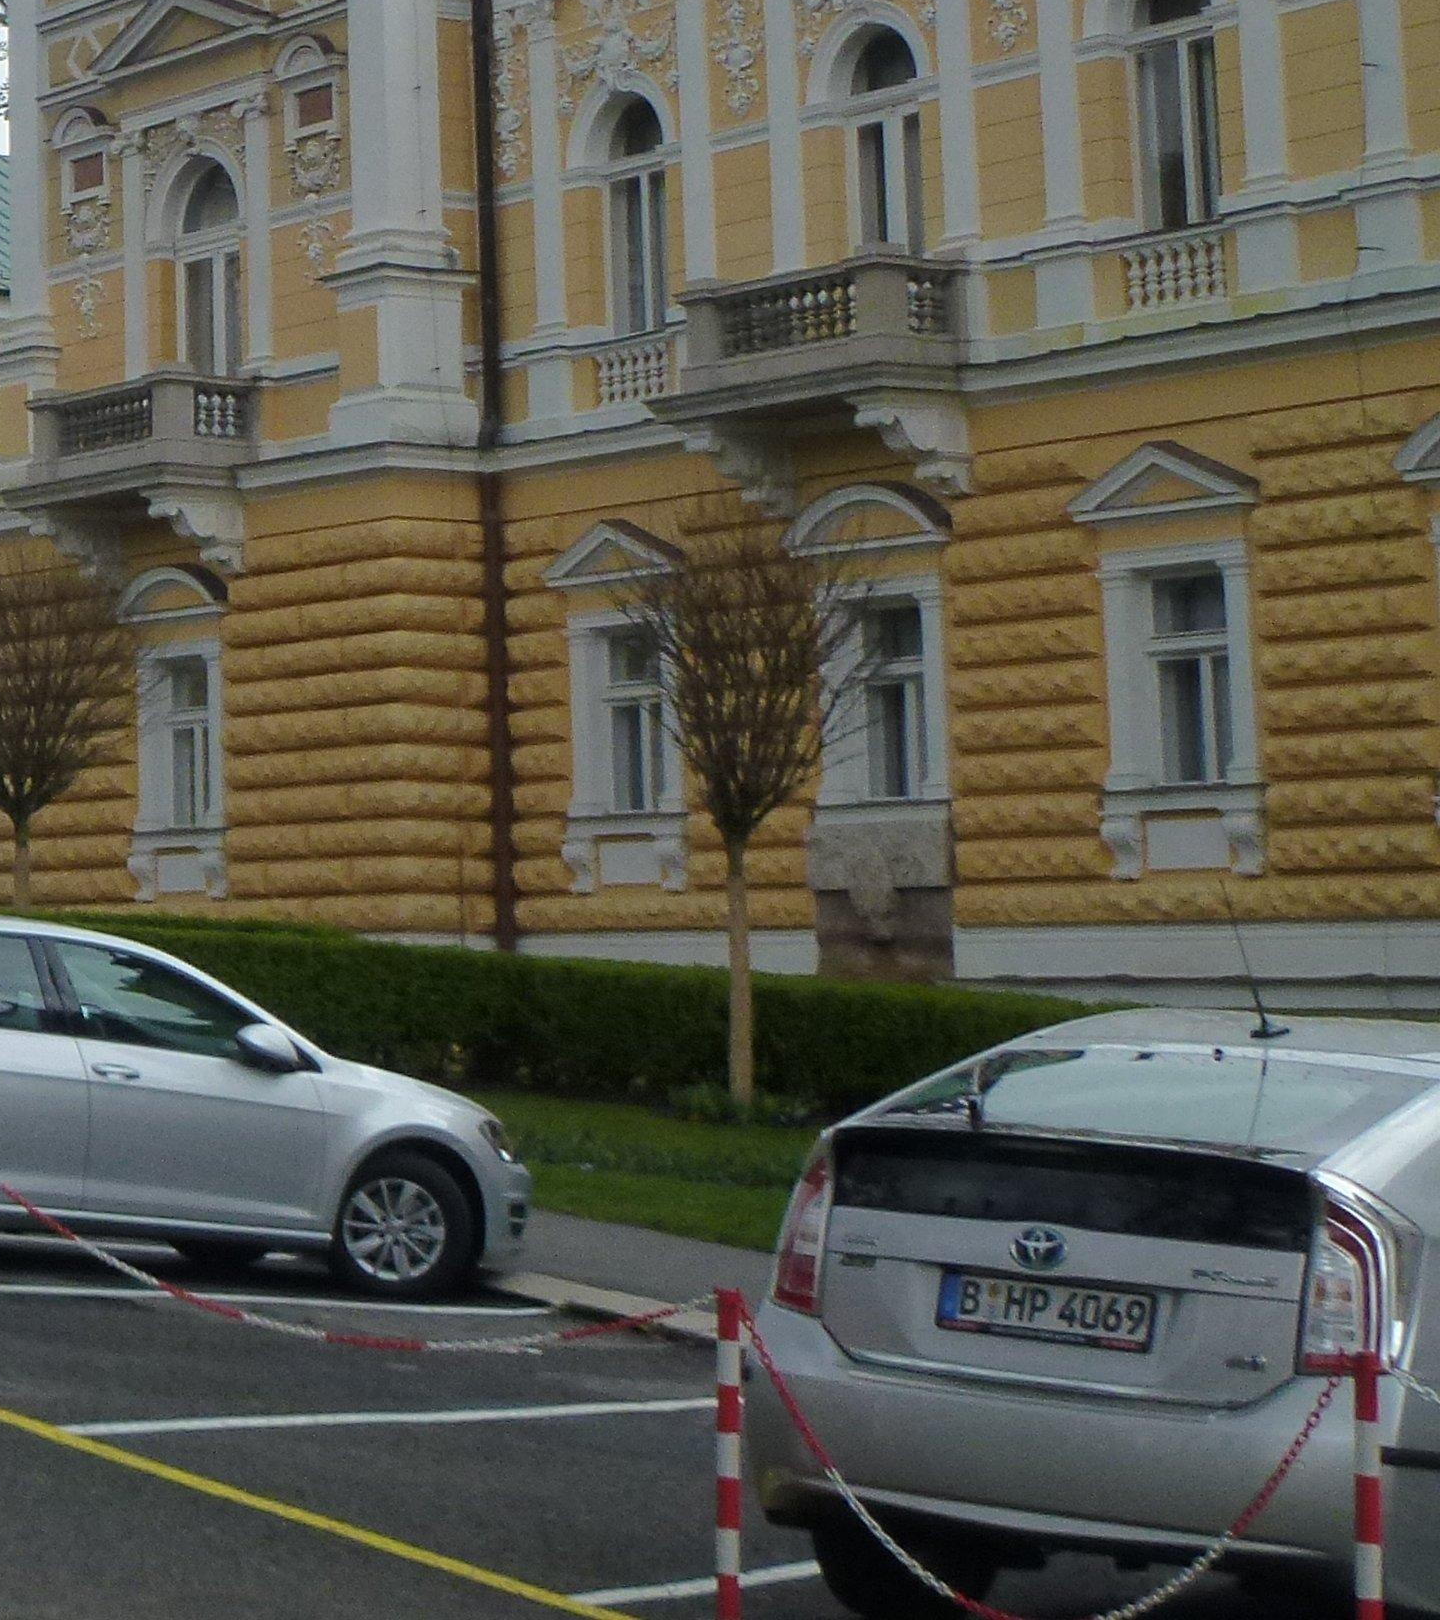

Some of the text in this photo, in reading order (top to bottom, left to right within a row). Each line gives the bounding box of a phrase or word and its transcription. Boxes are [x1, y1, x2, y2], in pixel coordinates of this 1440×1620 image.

[960, 1281, 981, 1315] B
[1004, 1284, 1050, 1322] HP
[1057, 1291, 1146, 1335] 4069
